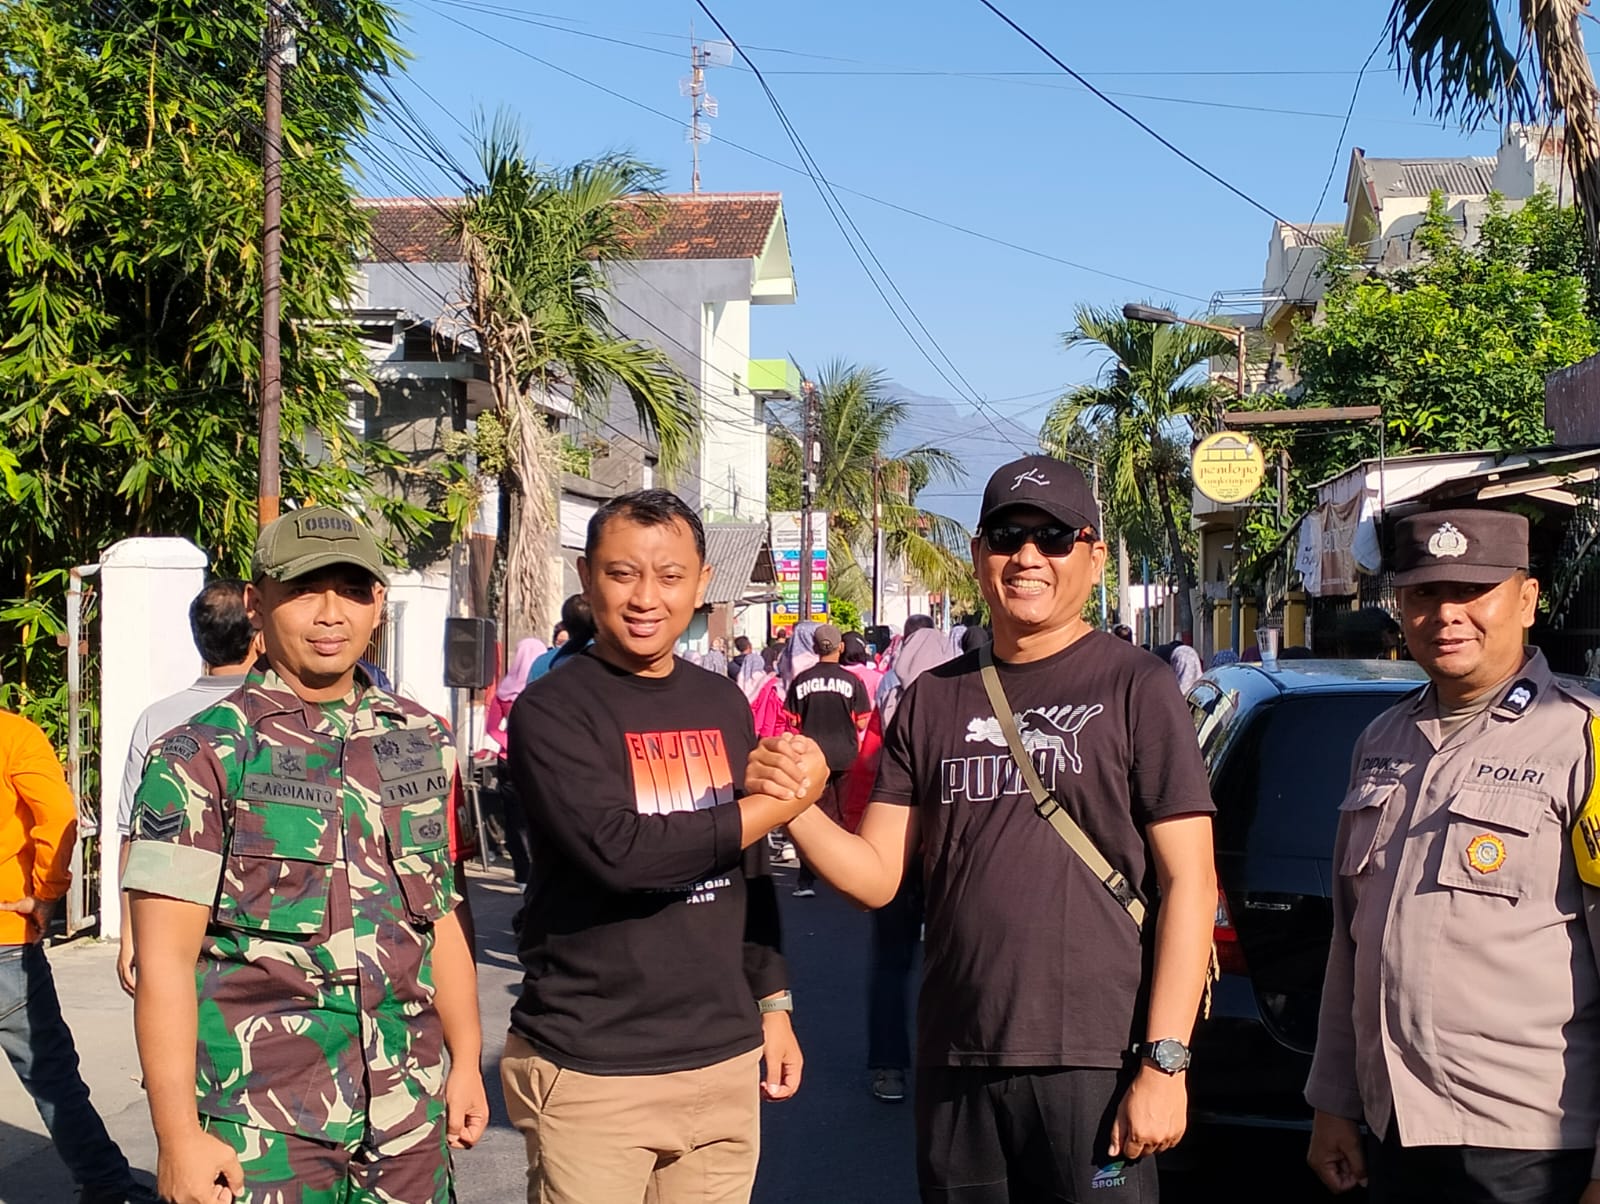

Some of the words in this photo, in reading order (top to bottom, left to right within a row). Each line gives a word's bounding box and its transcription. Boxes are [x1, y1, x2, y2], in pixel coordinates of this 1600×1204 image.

[1200, 463, 1258, 479] pendopo
[795, 677, 853, 701] ENGLAND
[629, 733, 719, 761] ENJOY
[1477, 763, 1545, 785] POLRI
[385, 781, 419, 801] TNI
[426, 775, 447, 793] AD
[1091, 1176, 1127, 1189] SPORT
